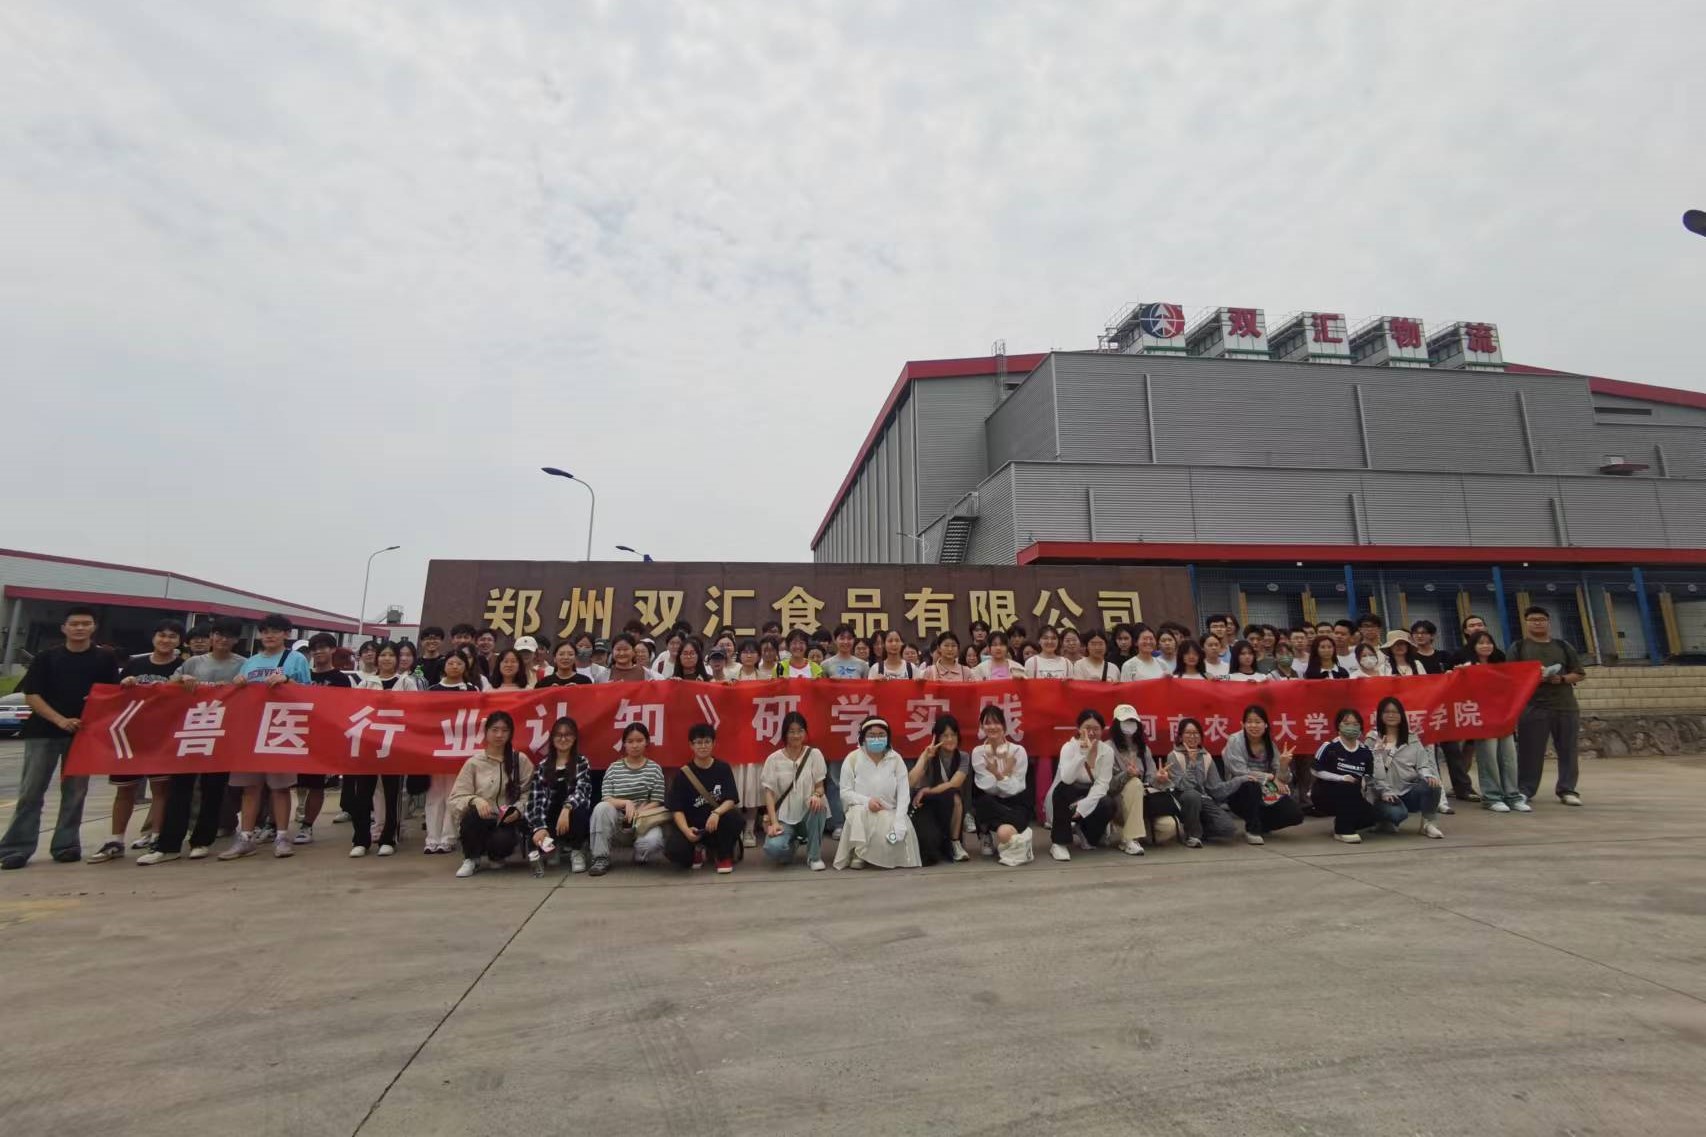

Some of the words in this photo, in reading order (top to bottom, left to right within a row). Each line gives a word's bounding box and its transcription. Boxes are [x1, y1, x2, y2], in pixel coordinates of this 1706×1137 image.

[1227, 307, 1497, 354] 双汇物流
[484, 586, 1142, 640] 郑州双汇食品有限公司
